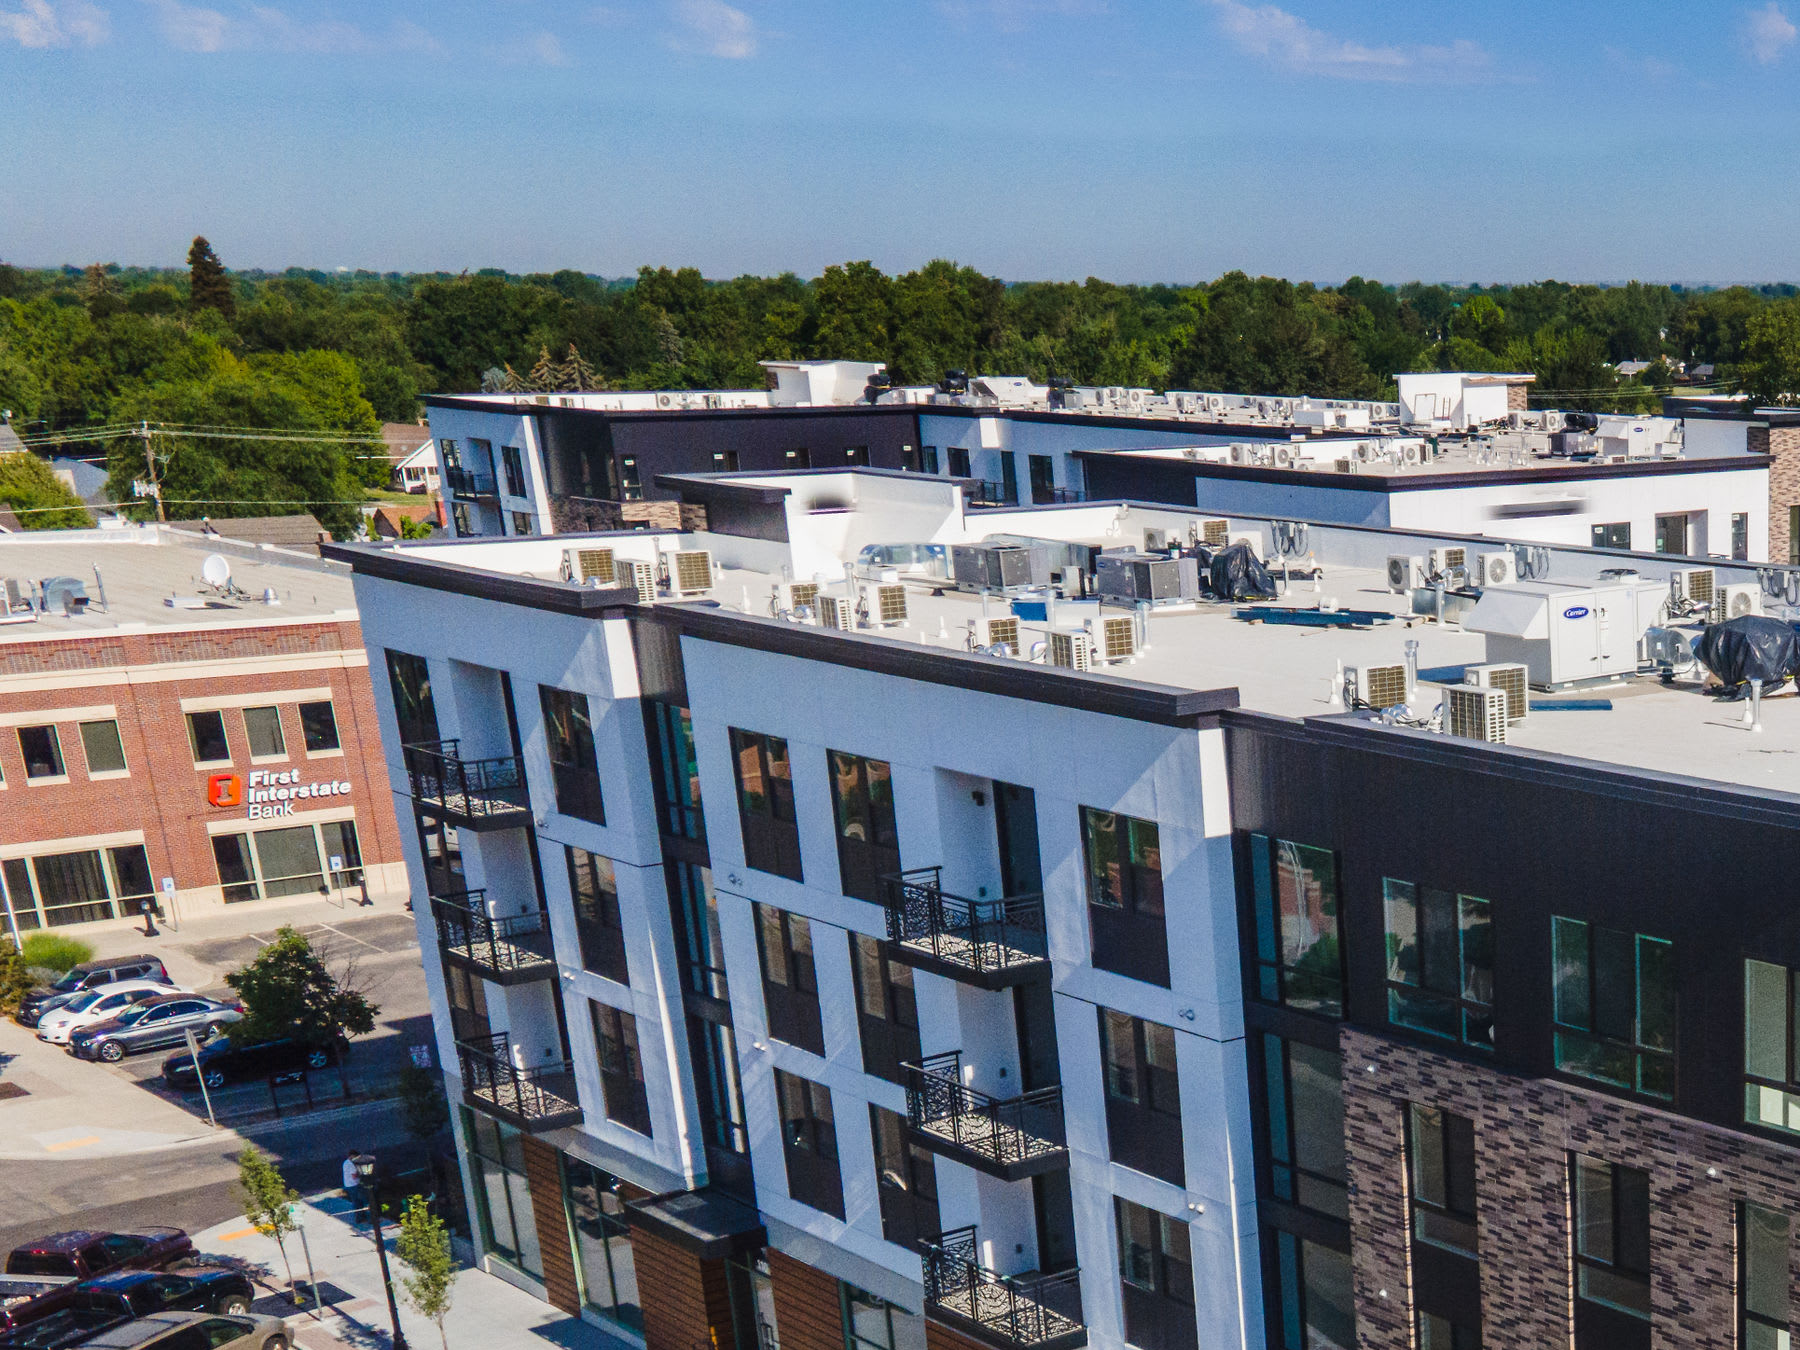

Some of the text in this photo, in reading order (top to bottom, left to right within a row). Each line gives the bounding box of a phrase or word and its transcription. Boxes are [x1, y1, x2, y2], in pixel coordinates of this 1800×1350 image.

[249, 768, 299, 787] First
[248, 780, 351, 804] Interstate
[248, 801, 294, 820] Bank
